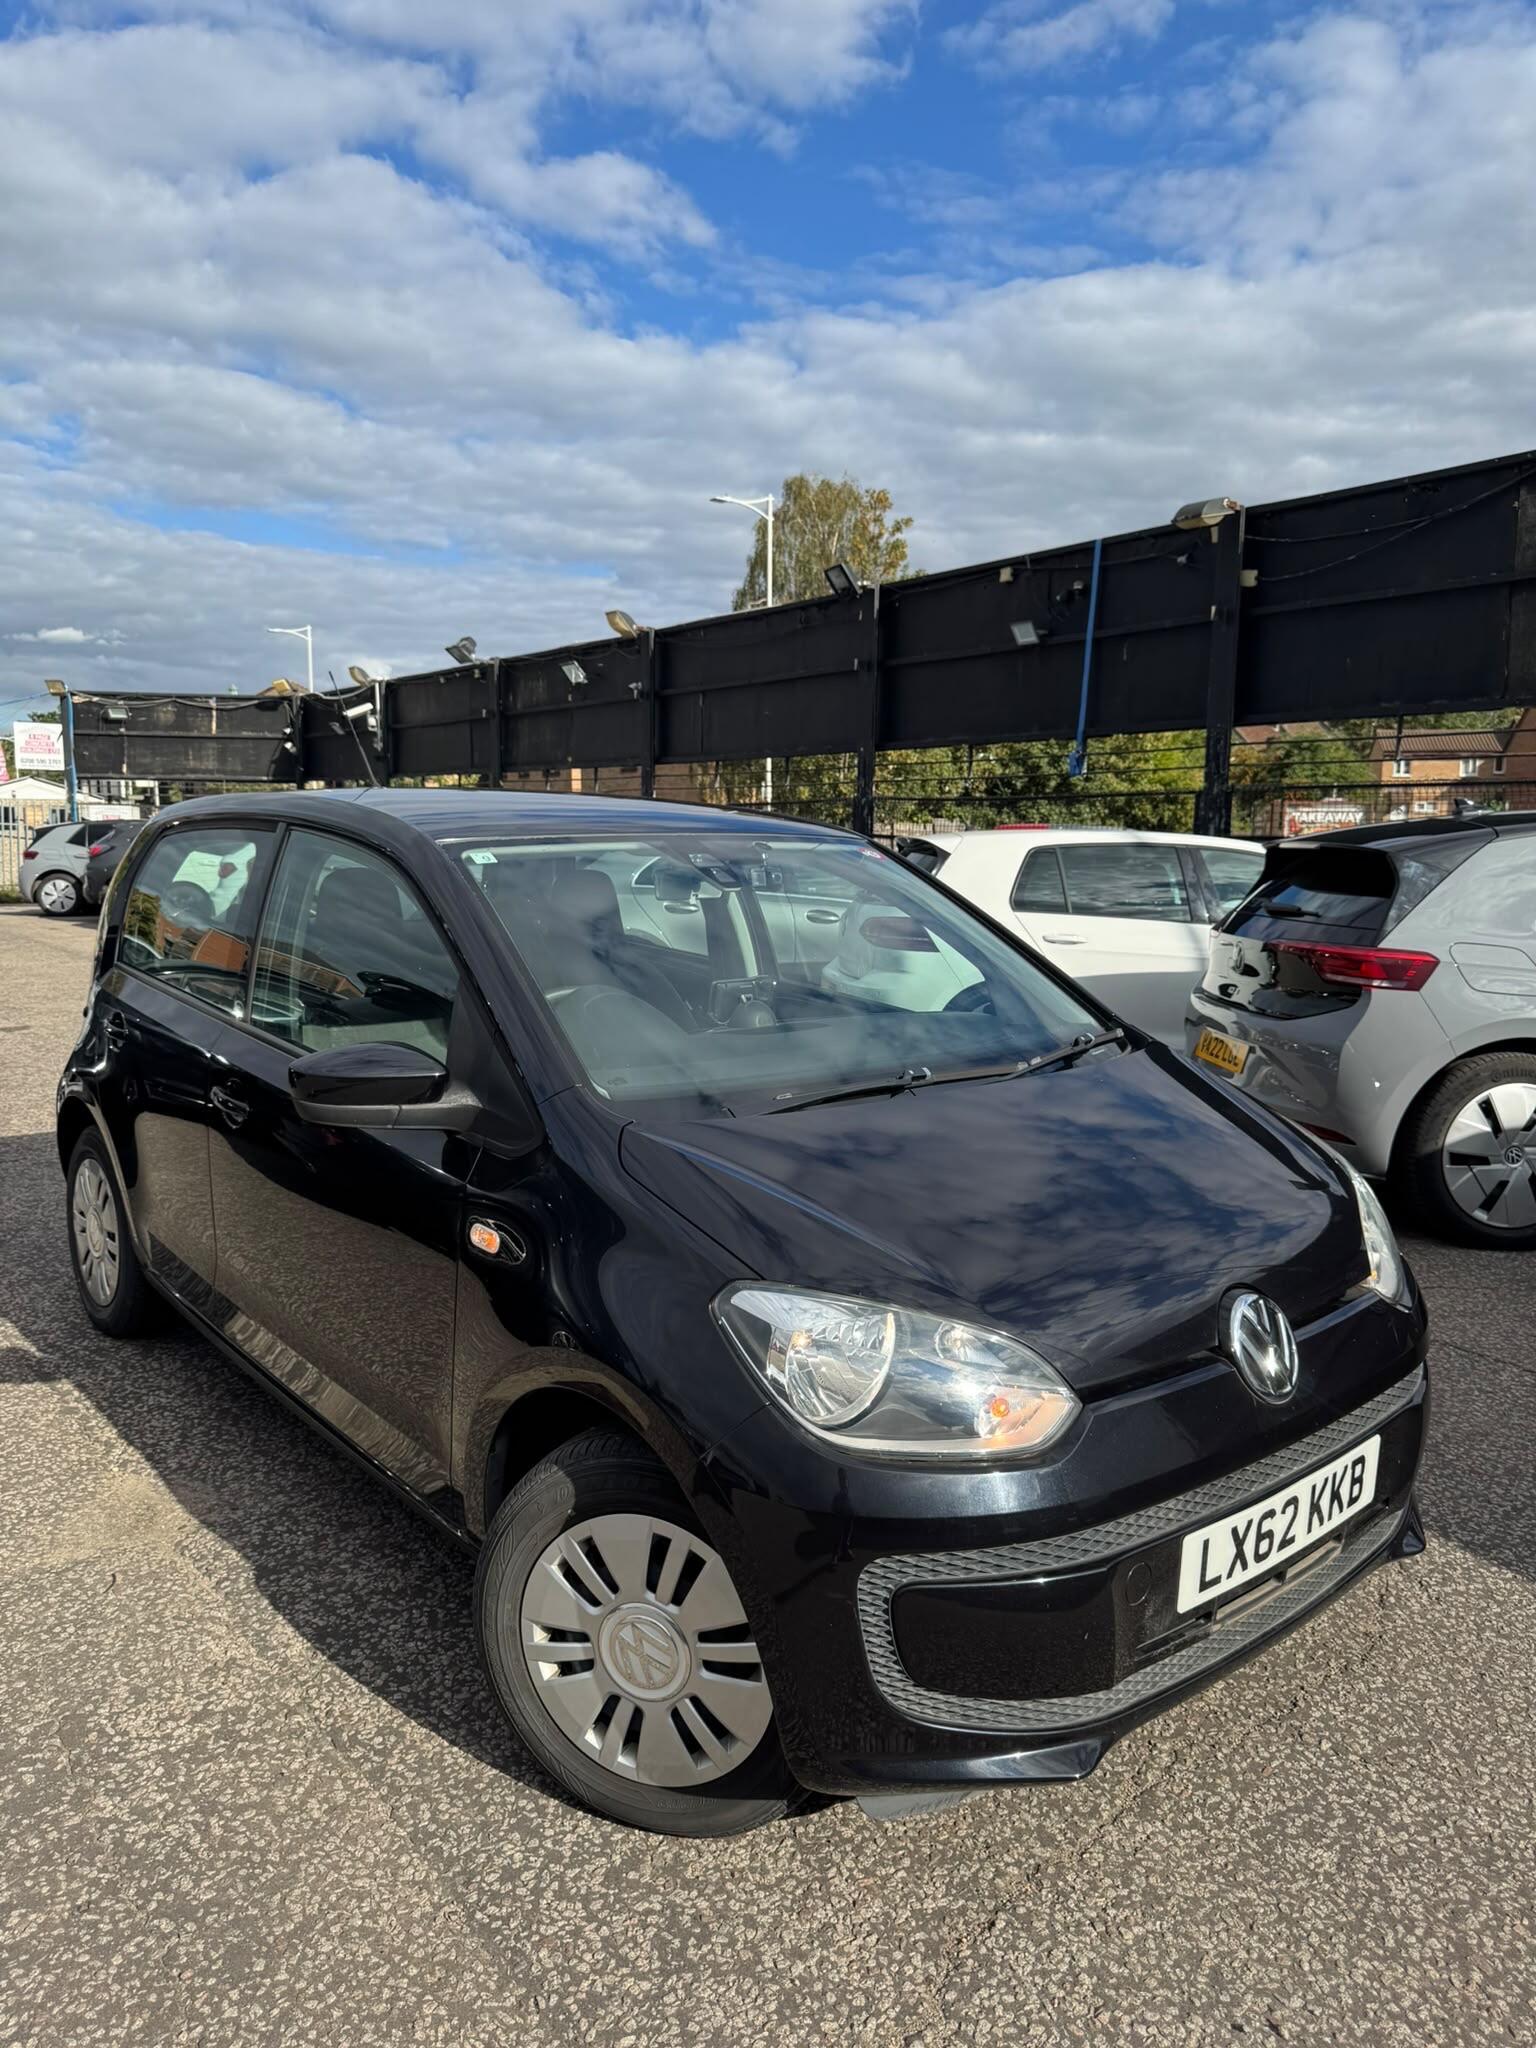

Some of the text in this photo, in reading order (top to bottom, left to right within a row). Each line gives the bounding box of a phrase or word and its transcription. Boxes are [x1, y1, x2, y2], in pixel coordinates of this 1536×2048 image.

[1291, 811, 1364, 825] TAKEAWAY
[1198, 1454, 1366, 1594] LX62 KKB
